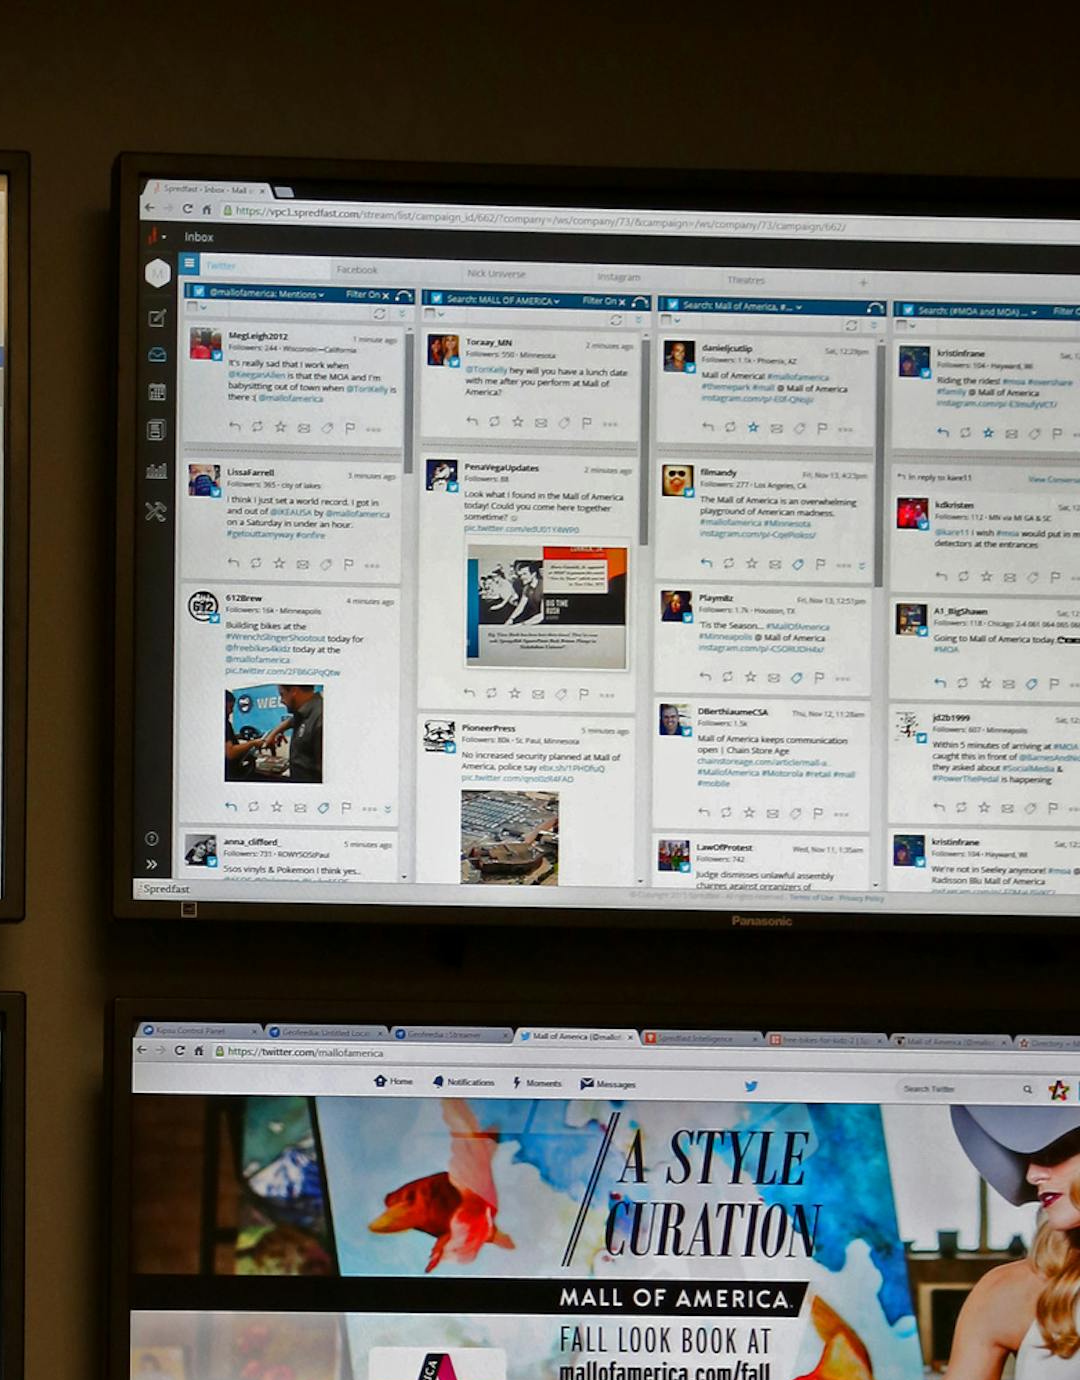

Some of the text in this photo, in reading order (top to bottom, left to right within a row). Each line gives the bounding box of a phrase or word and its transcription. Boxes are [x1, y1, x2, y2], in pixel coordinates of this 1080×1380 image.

[185, 232, 213, 242] Inbox
[337, 264, 378, 275] Facebook
[468, 269, 526, 279] Nick Universe
[728, 276, 765, 285] Theatres
[210, 289, 317, 299] @mallofamerica: Mentions
[447, 295, 477, 303] Search:
[479, 296, 501, 304] MALL
[516, 297, 553, 305] AMERICA
[229, 332, 288, 342] MegLeigh2012
[227, 468, 274, 477] LissaFarrell
[193, 600, 215, 611] 612
[462, 724, 515, 732] PioneerPress
[476, 752, 514, 760] increased
[549, 752, 582, 762] planned
[612, 753, 621, 762] of
[144, 885, 191, 895] Spredfast
[732, 915, 792, 927] Panasonic
[227, 1046, 385, 1060] https://twitter.com/mallofamerica
[527, 1080, 562, 1088] Moments
[597, 1080, 636, 1090] Messages
[616, 1129, 810, 1186] A STYLE
[605, 1201, 823, 1258] CURATION
[560, 1289, 626, 1308] MALL
[634, 1290, 666, 1308] OF
[560, 1327, 772, 1354] FALL LOOK BOOK AT
